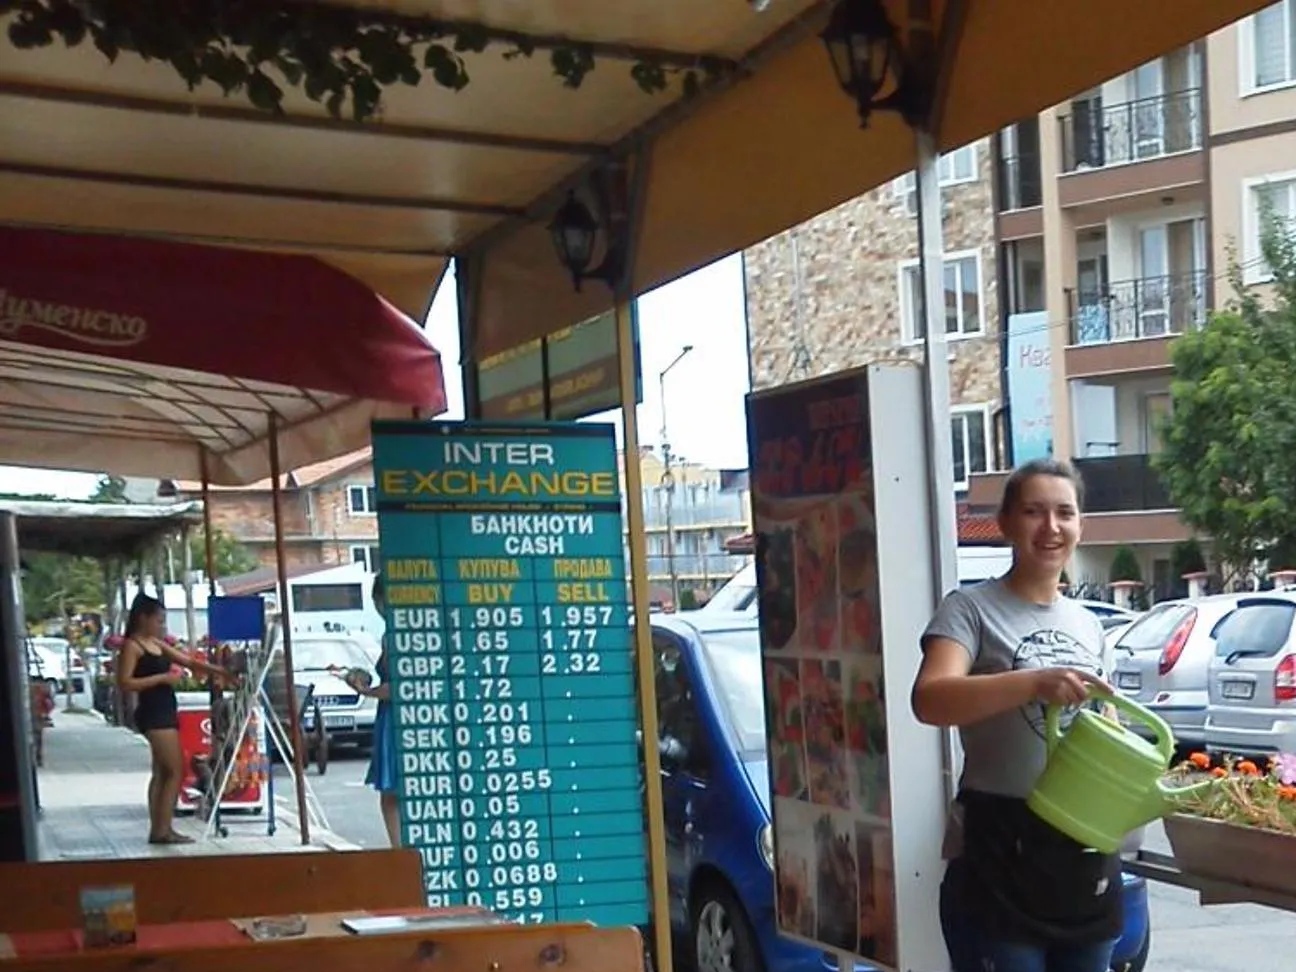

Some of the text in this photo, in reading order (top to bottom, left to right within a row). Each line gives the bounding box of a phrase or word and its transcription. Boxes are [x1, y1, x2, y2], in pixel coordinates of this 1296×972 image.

[444, 441, 555, 466] INTER
[382, 470, 614, 496] EXCHANGE
[471, 514, 594, 535] БАНКНОТИ
[504, 536, 564, 555] CASH
[458, 559, 521, 580] КУПУВА
[553, 559, 612, 579] ПРОДАВА
[468, 584, 514, 603] BUY
[557, 582, 609, 602] SELL
[393, 608, 441, 629] EUR
[394, 631, 442, 652] USD
[397, 658, 444, 676] GBP
[399, 681, 444, 700] CHF
[400, 704, 450, 725] NOK
[402, 729, 448, 749] SEK
[403, 752, 451, 772] DKK
[404, 776, 452, 797] RUR
[407, 799, 454, 820] UAH
[408, 823, 451, 844] PLN
[425, 869, 458, 890] ZK
